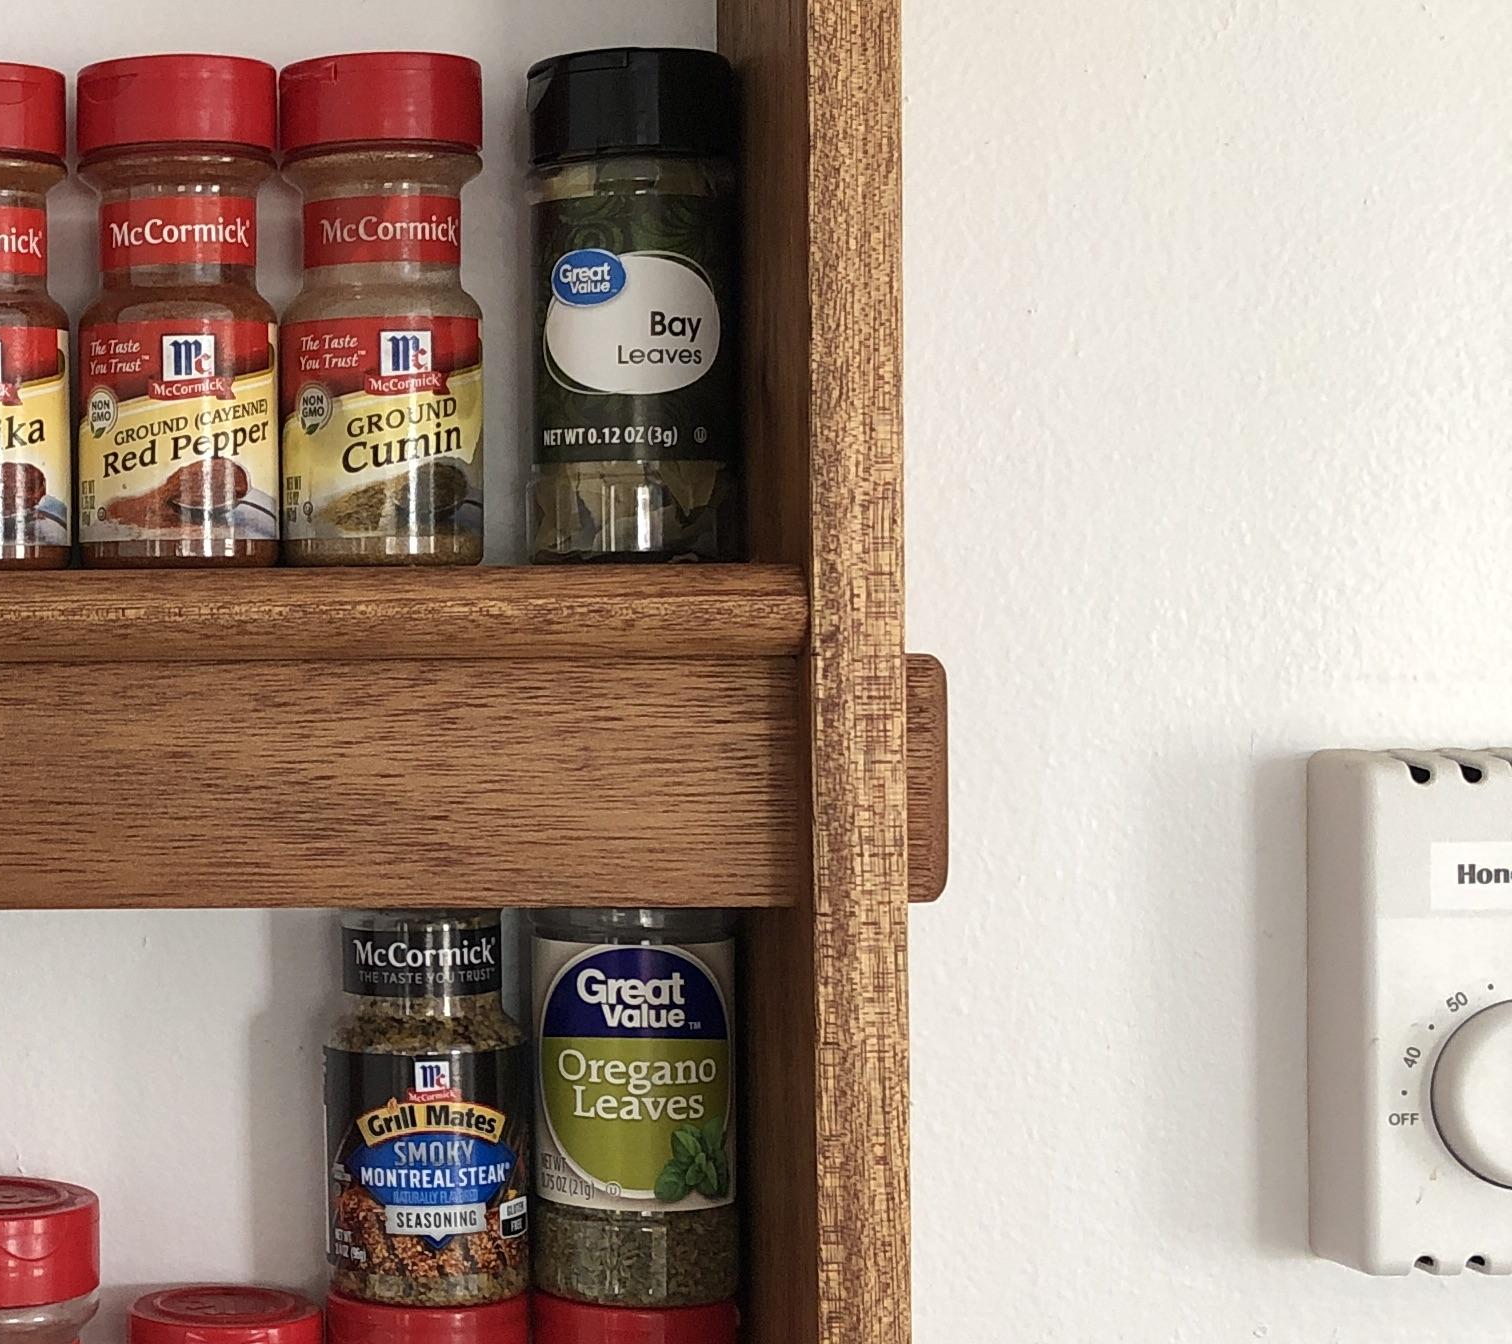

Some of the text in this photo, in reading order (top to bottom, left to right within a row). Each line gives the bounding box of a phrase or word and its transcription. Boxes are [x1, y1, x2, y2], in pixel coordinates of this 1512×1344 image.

[110, 219, 249, 247] McCormick
[321, 216, 457, 246] McCormick
[560, 263, 610, 282] Great
[570, 280, 610, 294] Value
[650, 311, 702, 343] Bay
[90, 341, 140, 355] The Taste
[301, 335, 358, 351] The Taste
[300, 355, 319, 371] You
[618, 345, 702, 364] Leaves
[90, 361, 107, 375] You
[153, 380, 223, 396] McCormick
[370, 374, 438, 392] McCormick
[92, 400, 110, 411] NON
[303, 395, 324, 406] NON
[92, 410, 111, 422] GMO
[302, 406, 324, 417] GMO
[347, 397, 457, 438] GROUND
[114, 399, 268, 446] GROUND (CAYENNE)
[544, 427, 677, 447] NET WT 0.12 OZ (3g)
[103, 421, 268, 478] Red Pepper
[342, 424, 462, 474] Cumin
[1458, 864, 1512, 884] Hon
[353, 938, 495, 967] McCormick
[359, 969, 490, 985] THE TASTE YOU TRUST
[576, 969, 684, 1005] Great
[1446, 991, 1469, 1013] 50
[602, 1003, 685, 1028] Value
[1403, 1046, 1422, 1068] 40
[558, 1049, 716, 1095] Oregano
[409, 1089, 455, 1103] McCormick
[573, 1085, 704, 1120] Leaves
[367, 1105, 497, 1137] Grill Mates
[1388, 1112, 1419, 1126] OFF
[394, 1140, 474, 1167] SMOKY
[361, 1167, 456, 1188] MONTREAL
[459, 1165, 506, 1187] STEAK
[556, 1176, 566, 1193] OZ
[397, 1211, 476, 1228] SEASONING
